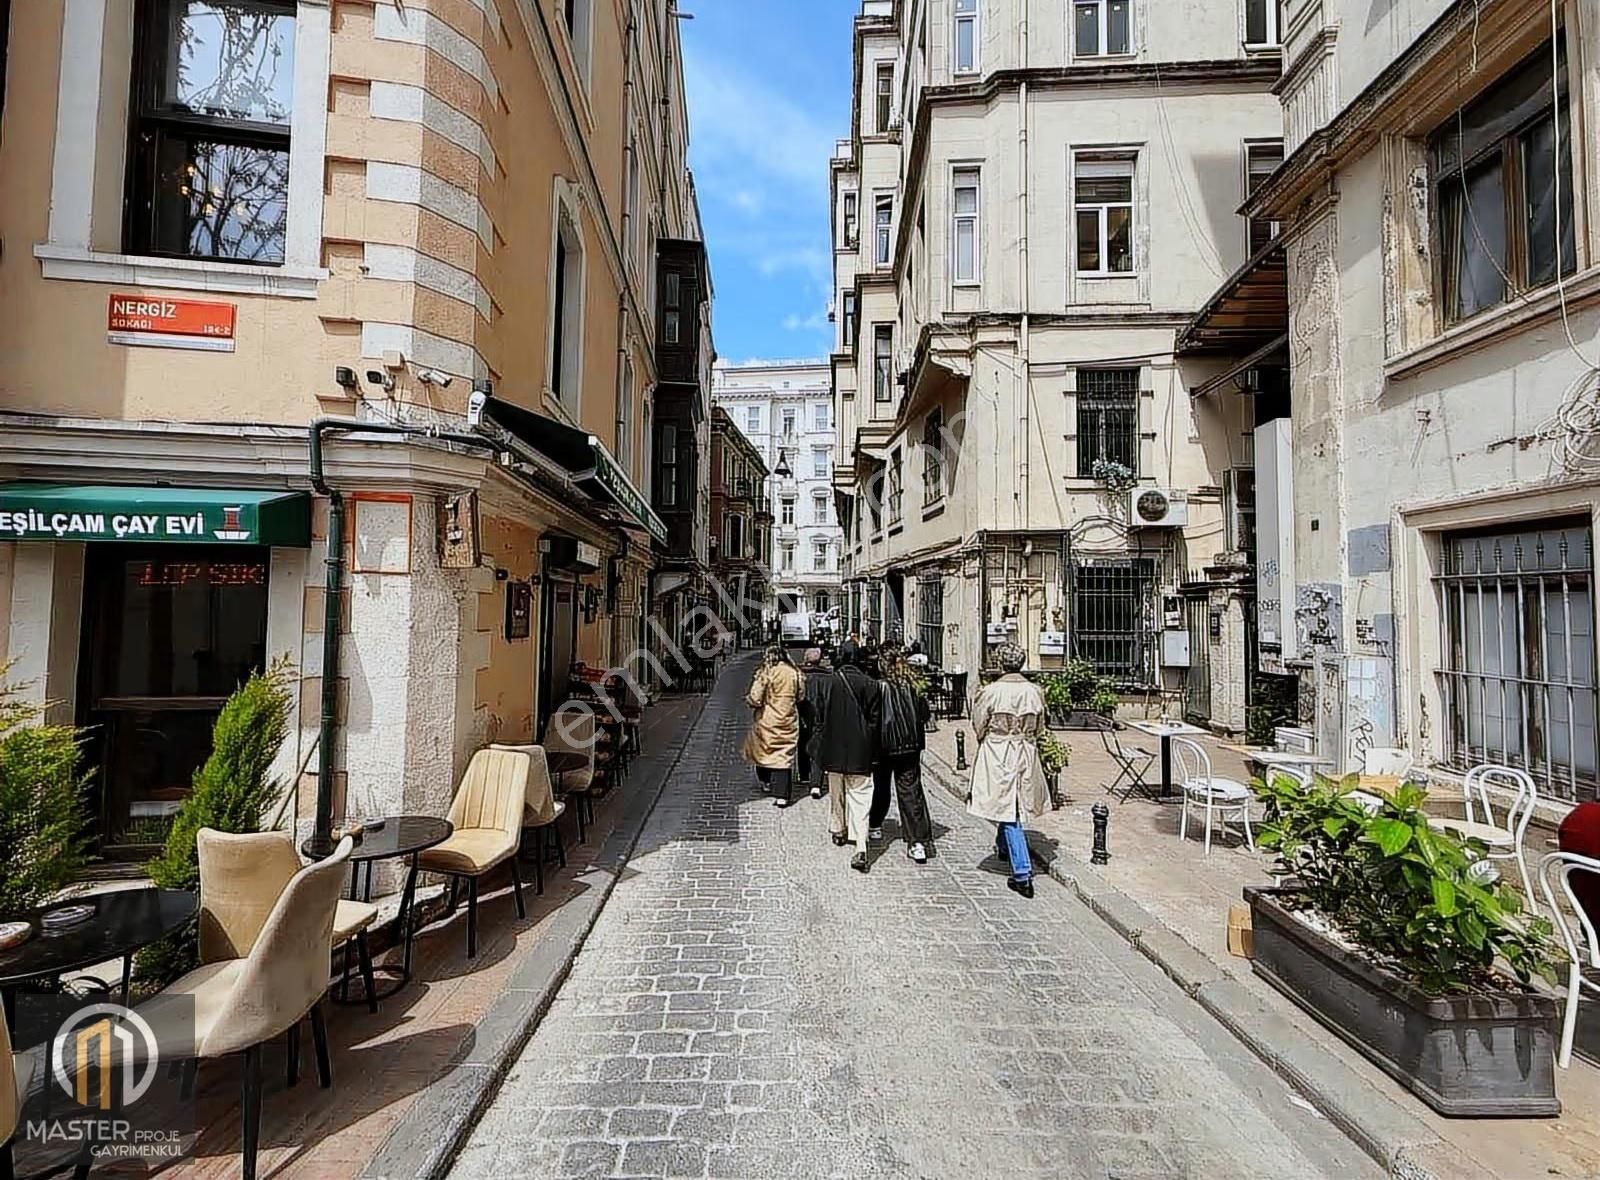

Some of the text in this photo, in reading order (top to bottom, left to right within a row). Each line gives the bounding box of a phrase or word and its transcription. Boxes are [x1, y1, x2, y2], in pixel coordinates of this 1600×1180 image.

[113, 301, 176, 318] NERGİZ
[112, 516, 158, 537] ÇAY
[166, 513, 204, 534] EVİ
